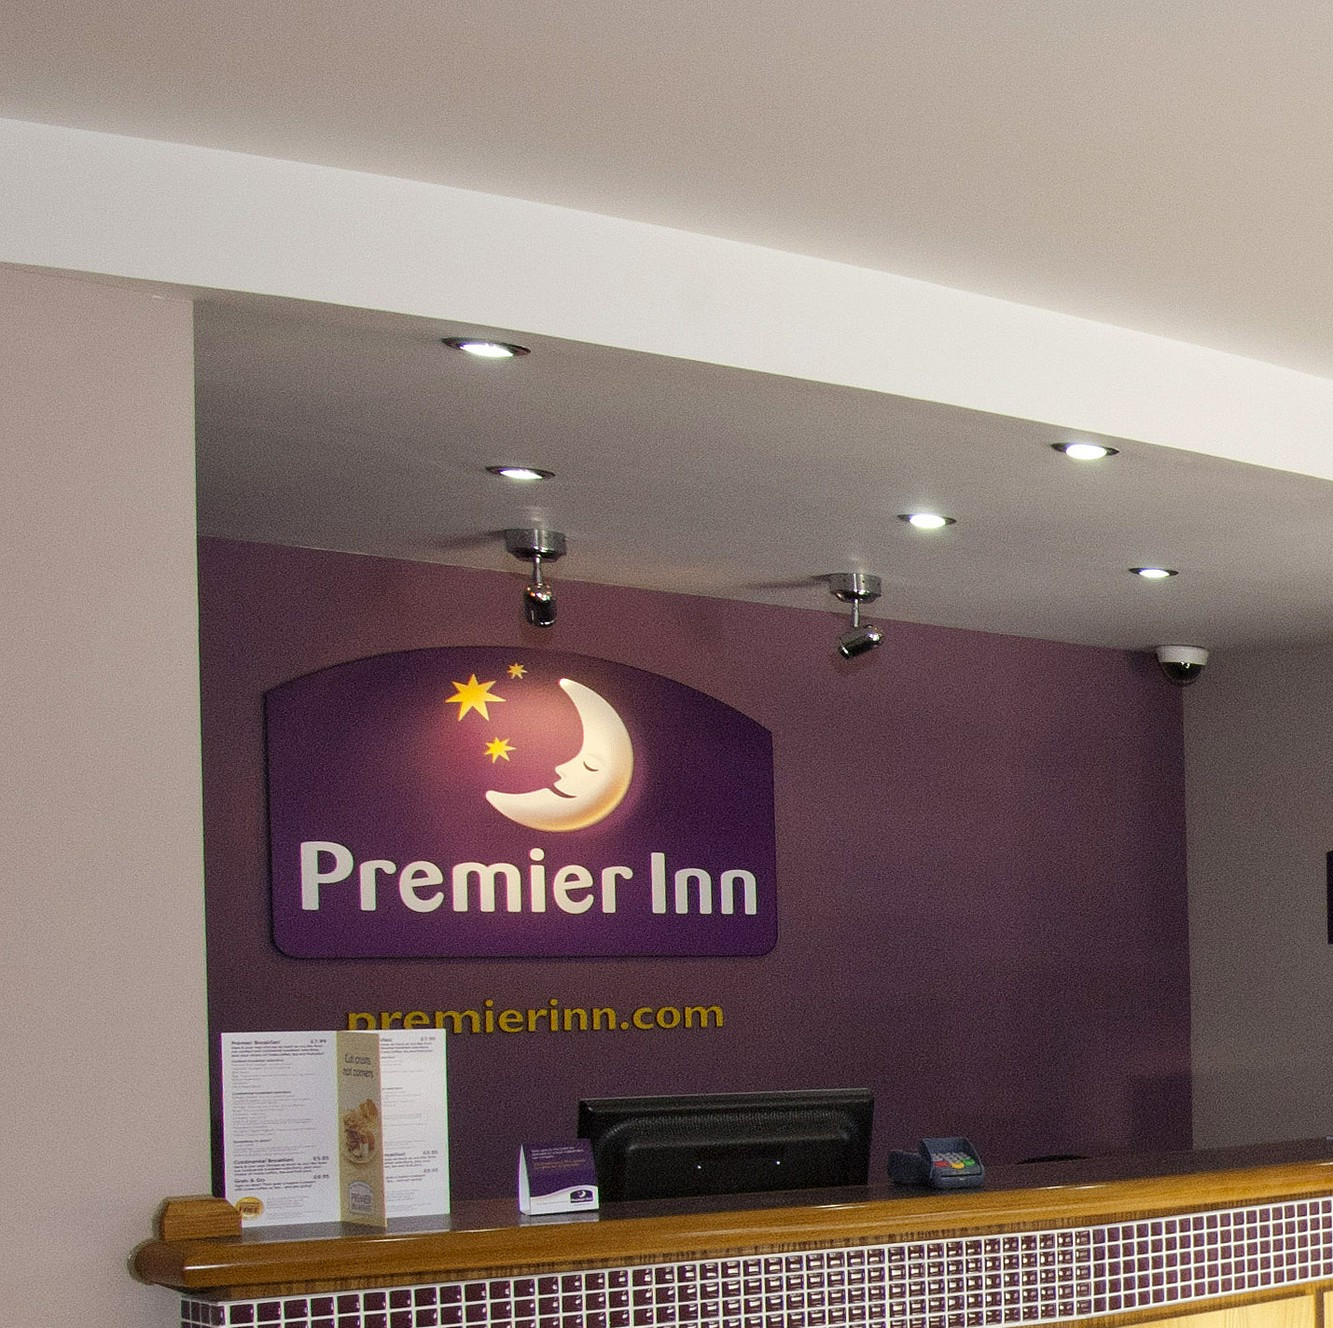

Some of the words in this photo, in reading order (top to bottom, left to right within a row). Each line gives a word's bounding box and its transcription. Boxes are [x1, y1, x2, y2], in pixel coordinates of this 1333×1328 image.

[300, 841, 633, 914] Premier
[651, 852, 757, 915] Inn
[347, 999, 724, 1034] premierinn.com
